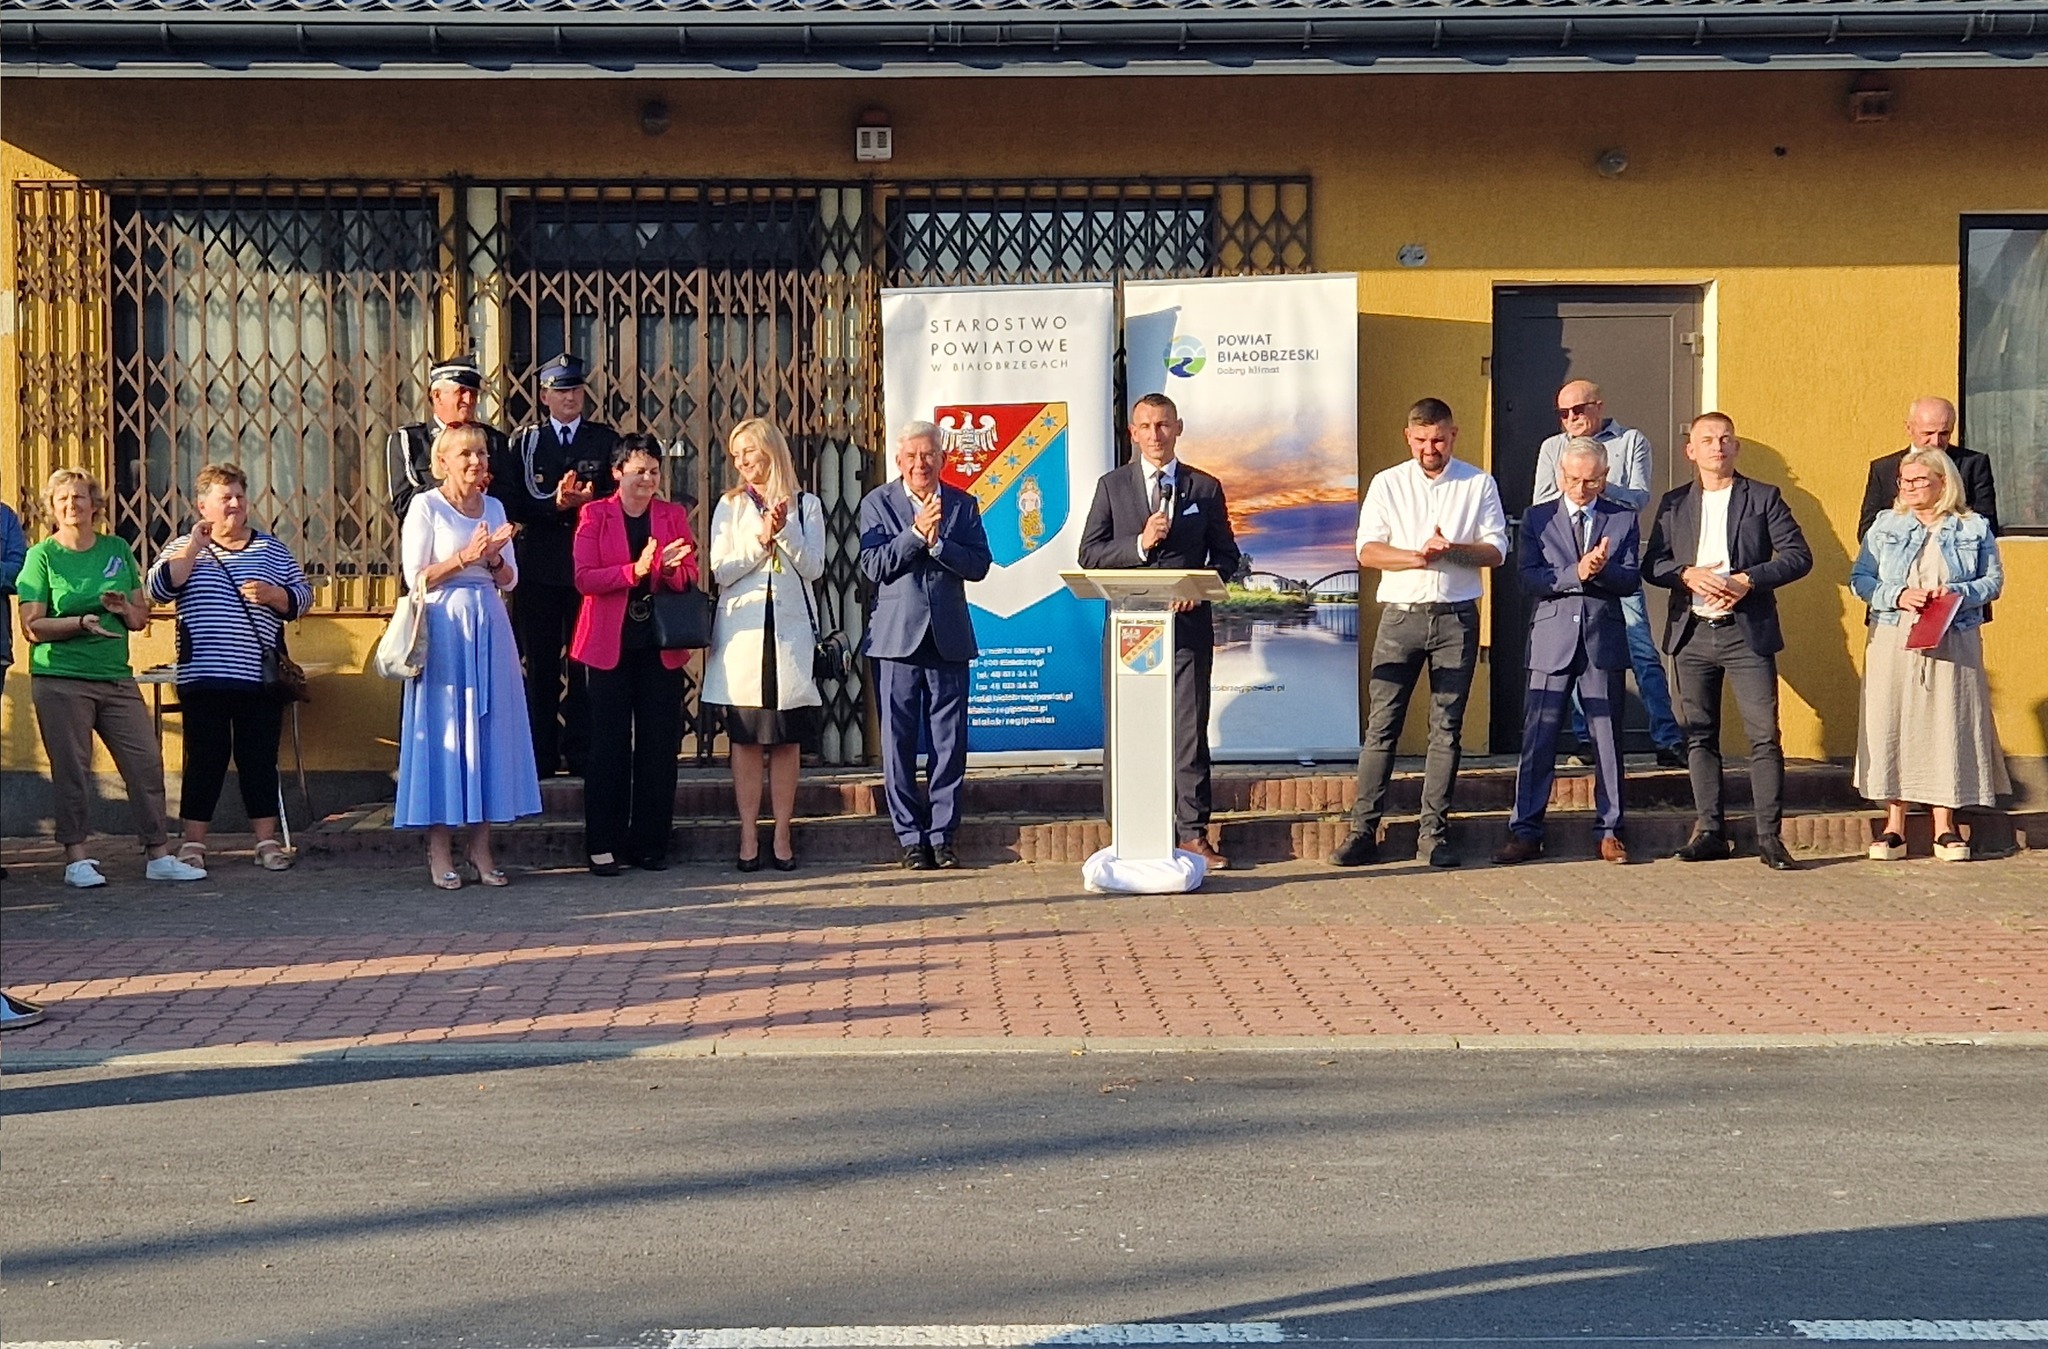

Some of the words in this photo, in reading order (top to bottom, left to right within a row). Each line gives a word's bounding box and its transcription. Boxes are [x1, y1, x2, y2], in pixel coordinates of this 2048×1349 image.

[930, 316, 1067, 333] STAROSTWO
[931, 338, 1067, 356] POWIATOWE
[1217, 334, 1272, 346] POWIAT
[1217, 349, 1319, 363] BIAŁOBRZESKI
[931, 363, 942, 372] W
[953, 359, 1068, 372] BIAŁOBRZEGACH
